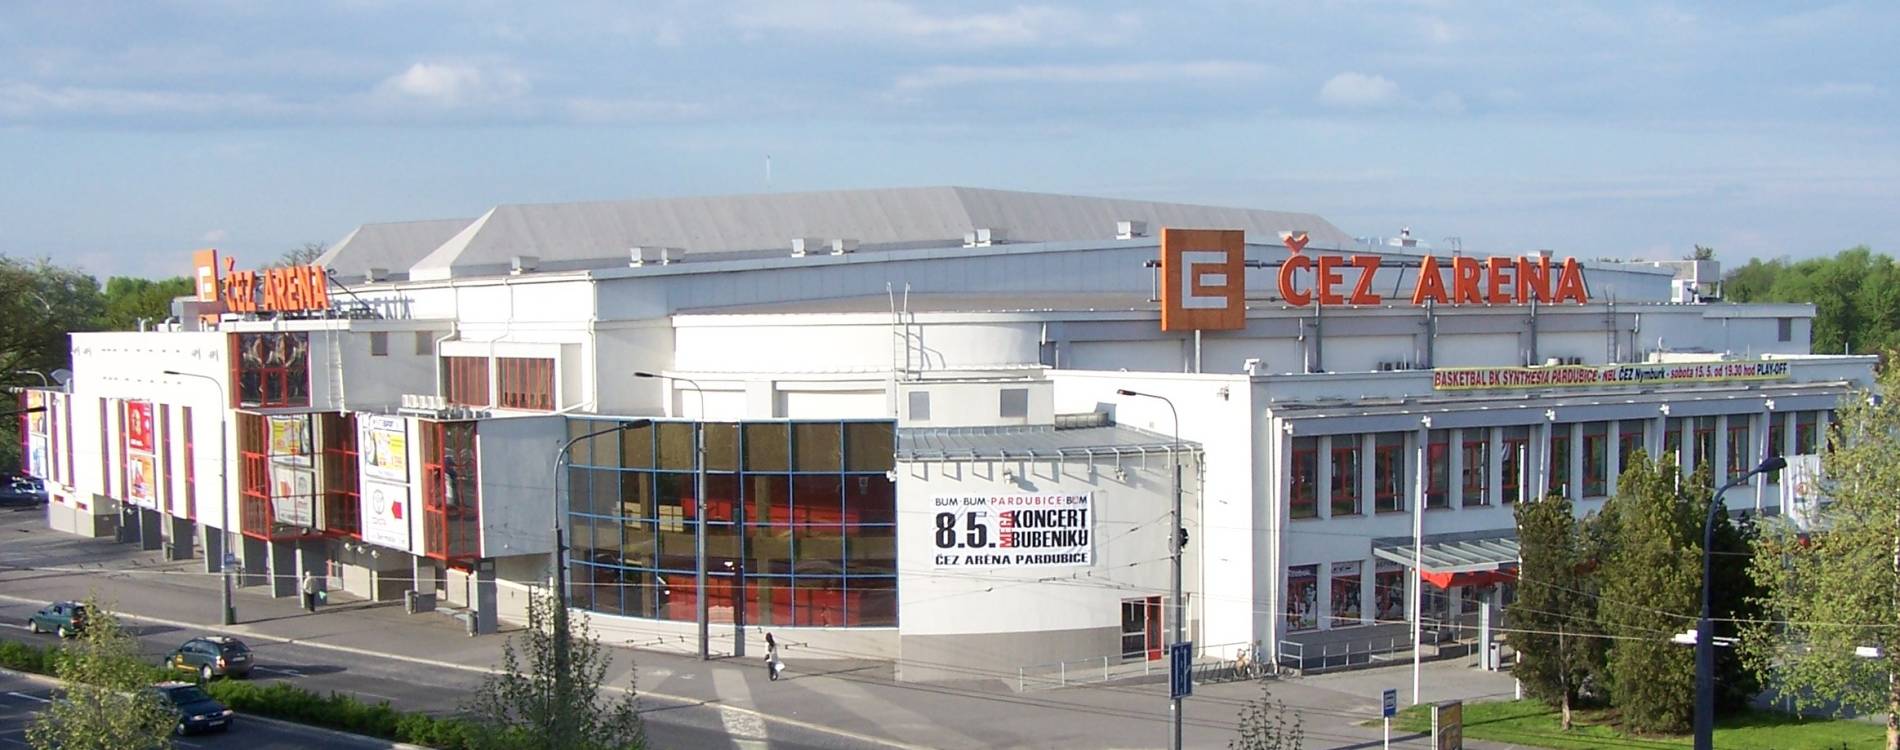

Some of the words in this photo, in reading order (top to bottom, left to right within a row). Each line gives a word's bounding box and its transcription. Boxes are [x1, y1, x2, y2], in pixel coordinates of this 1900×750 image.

[225, 256, 257, 312] ČEZ
[263, 265, 328, 311] ARENA
[1278, 233, 1381, 306] ČEZ
[1413, 255, 1588, 305] ARENA
[1434, 371, 1486, 386] BASKETBAL
[1489, 370, 1500, 385] BK
[1502, 369, 1549, 385] SYNTHESIA
[1552, 367, 1598, 384] PARDUBICE
[1602, 369, 1616, 382] NBL
[1619, 366, 1634, 381] ČEZ
[1635, 367, 1665, 383] Nymburk
[1671, 366, 1694, 378] sobota
[1714, 364, 1723, 377] od
[1743, 364, 1755, 376] hod
[1757, 362, 1787, 375] PLAY-OFF
[935, 497, 958, 506] BUM
[963, 497, 986, 506] BUM
[991, 495, 1062, 506] PARDUBICE
[935, 511, 996, 549] 8.5.
[999, 511, 1013, 548] MEGA
[1011, 508, 1087, 529] KONCERT
[935, 553, 960, 566] ČEZ
[1015, 553, 1088, 565] PARDUBICE
